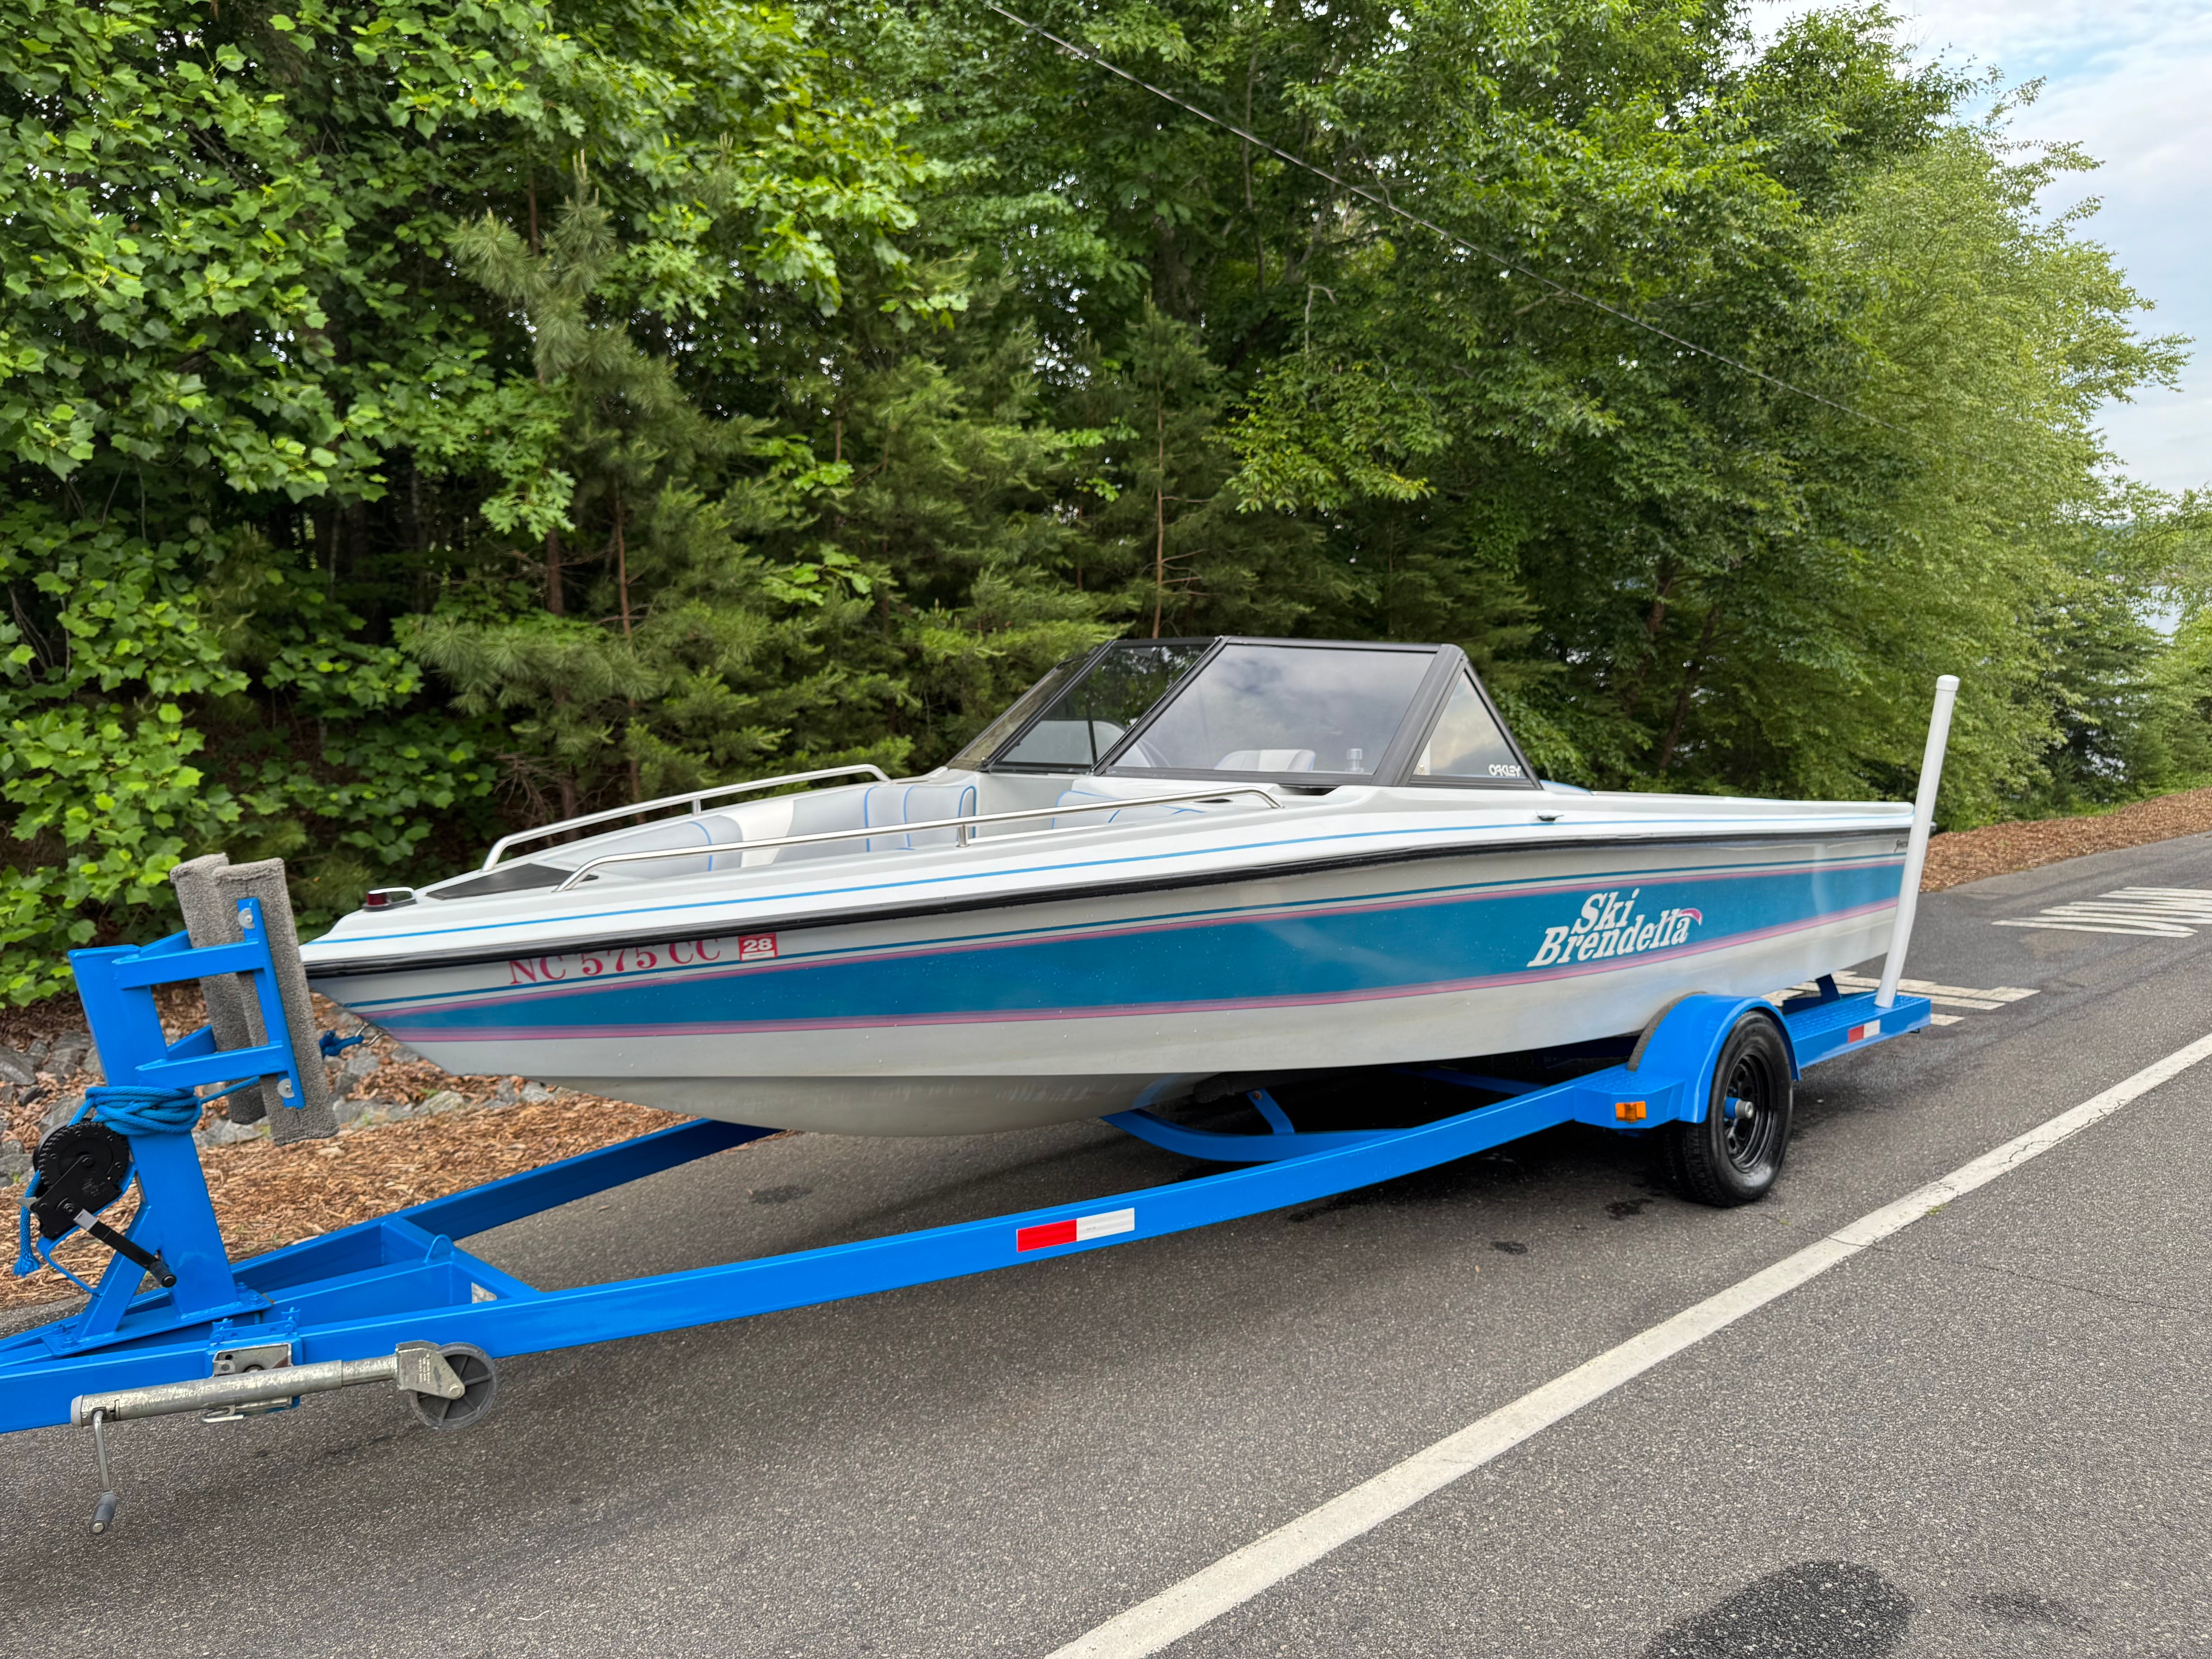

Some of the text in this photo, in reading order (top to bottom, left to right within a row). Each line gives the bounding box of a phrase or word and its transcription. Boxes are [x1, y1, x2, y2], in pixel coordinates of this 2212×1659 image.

[1488, 764, 1521, 777] OAKLEY
[1571, 888, 1640, 934] Ski
[743, 938, 773, 952] 28
[1527, 908, 1692, 967] Brendella
[509, 938, 721, 985] NC 575 CC
